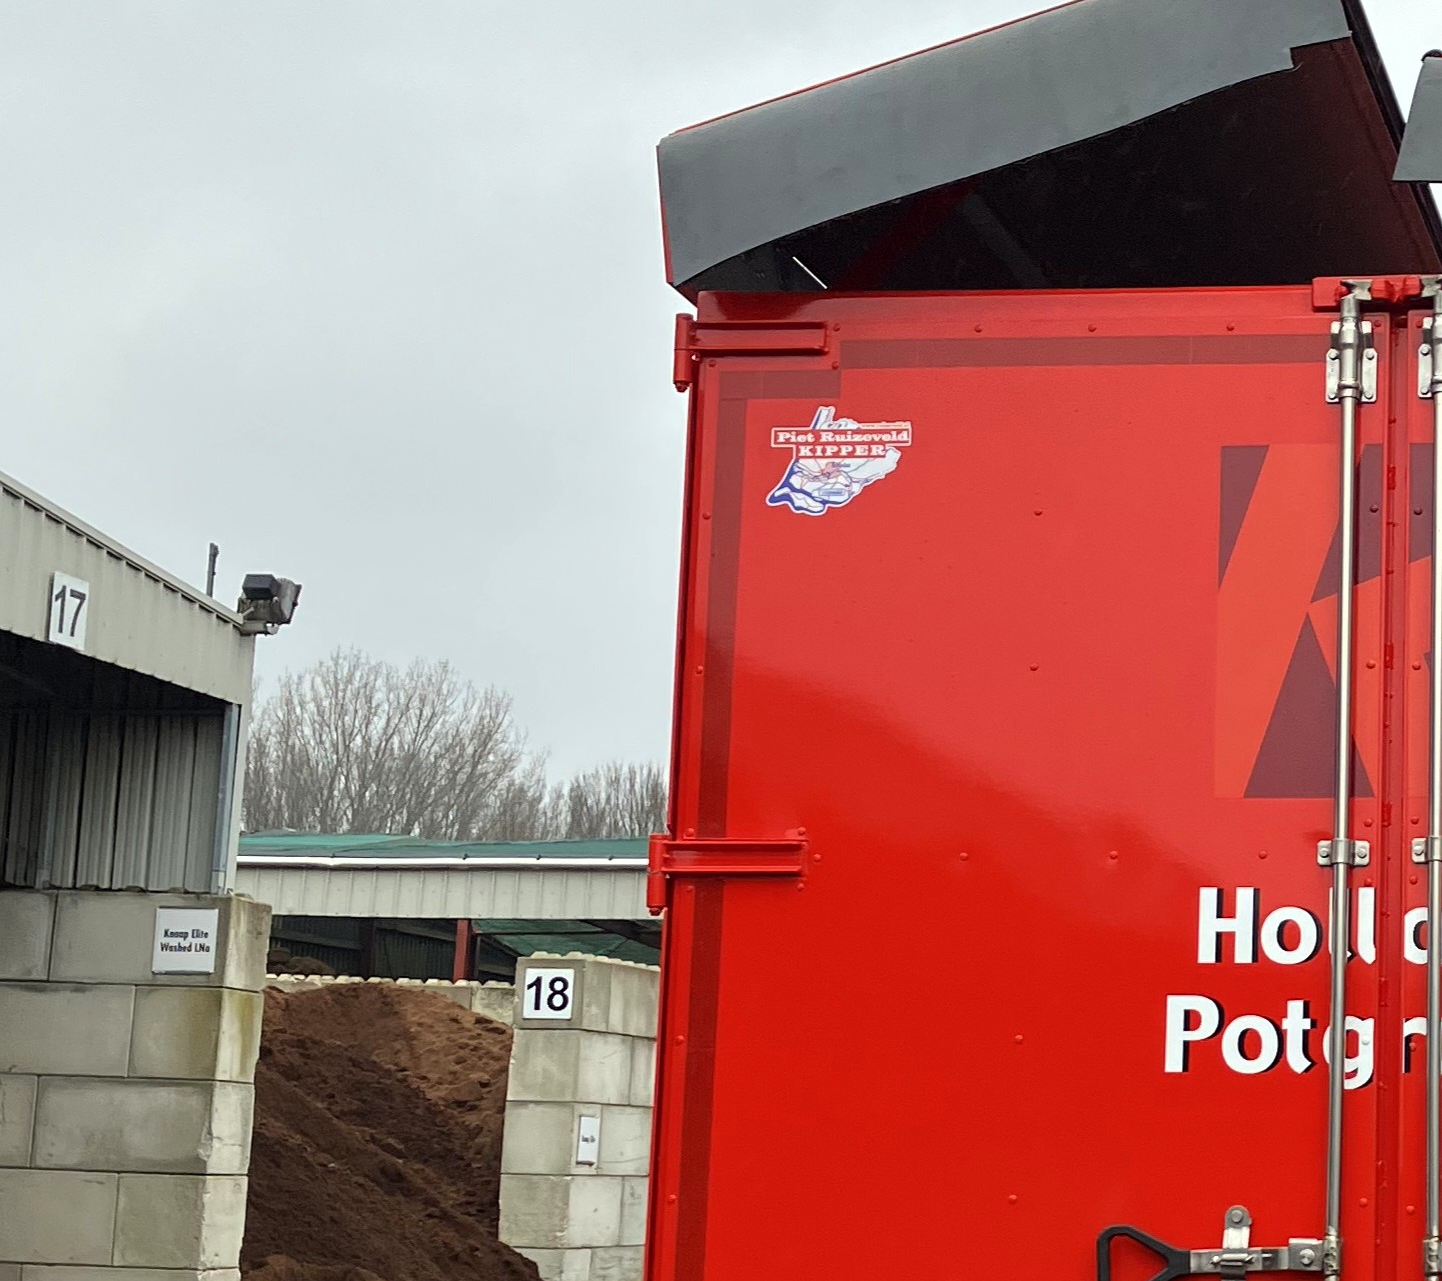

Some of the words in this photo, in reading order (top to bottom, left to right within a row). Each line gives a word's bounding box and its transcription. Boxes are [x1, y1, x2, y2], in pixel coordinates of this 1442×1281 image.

[777, 431, 815, 442] Piet
[820, 430, 909, 442] Ruizeveld
[798, 445, 885, 456] KIPPER
[55, 585, 86, 637] 17
[527, 976, 569, 1011] 18
